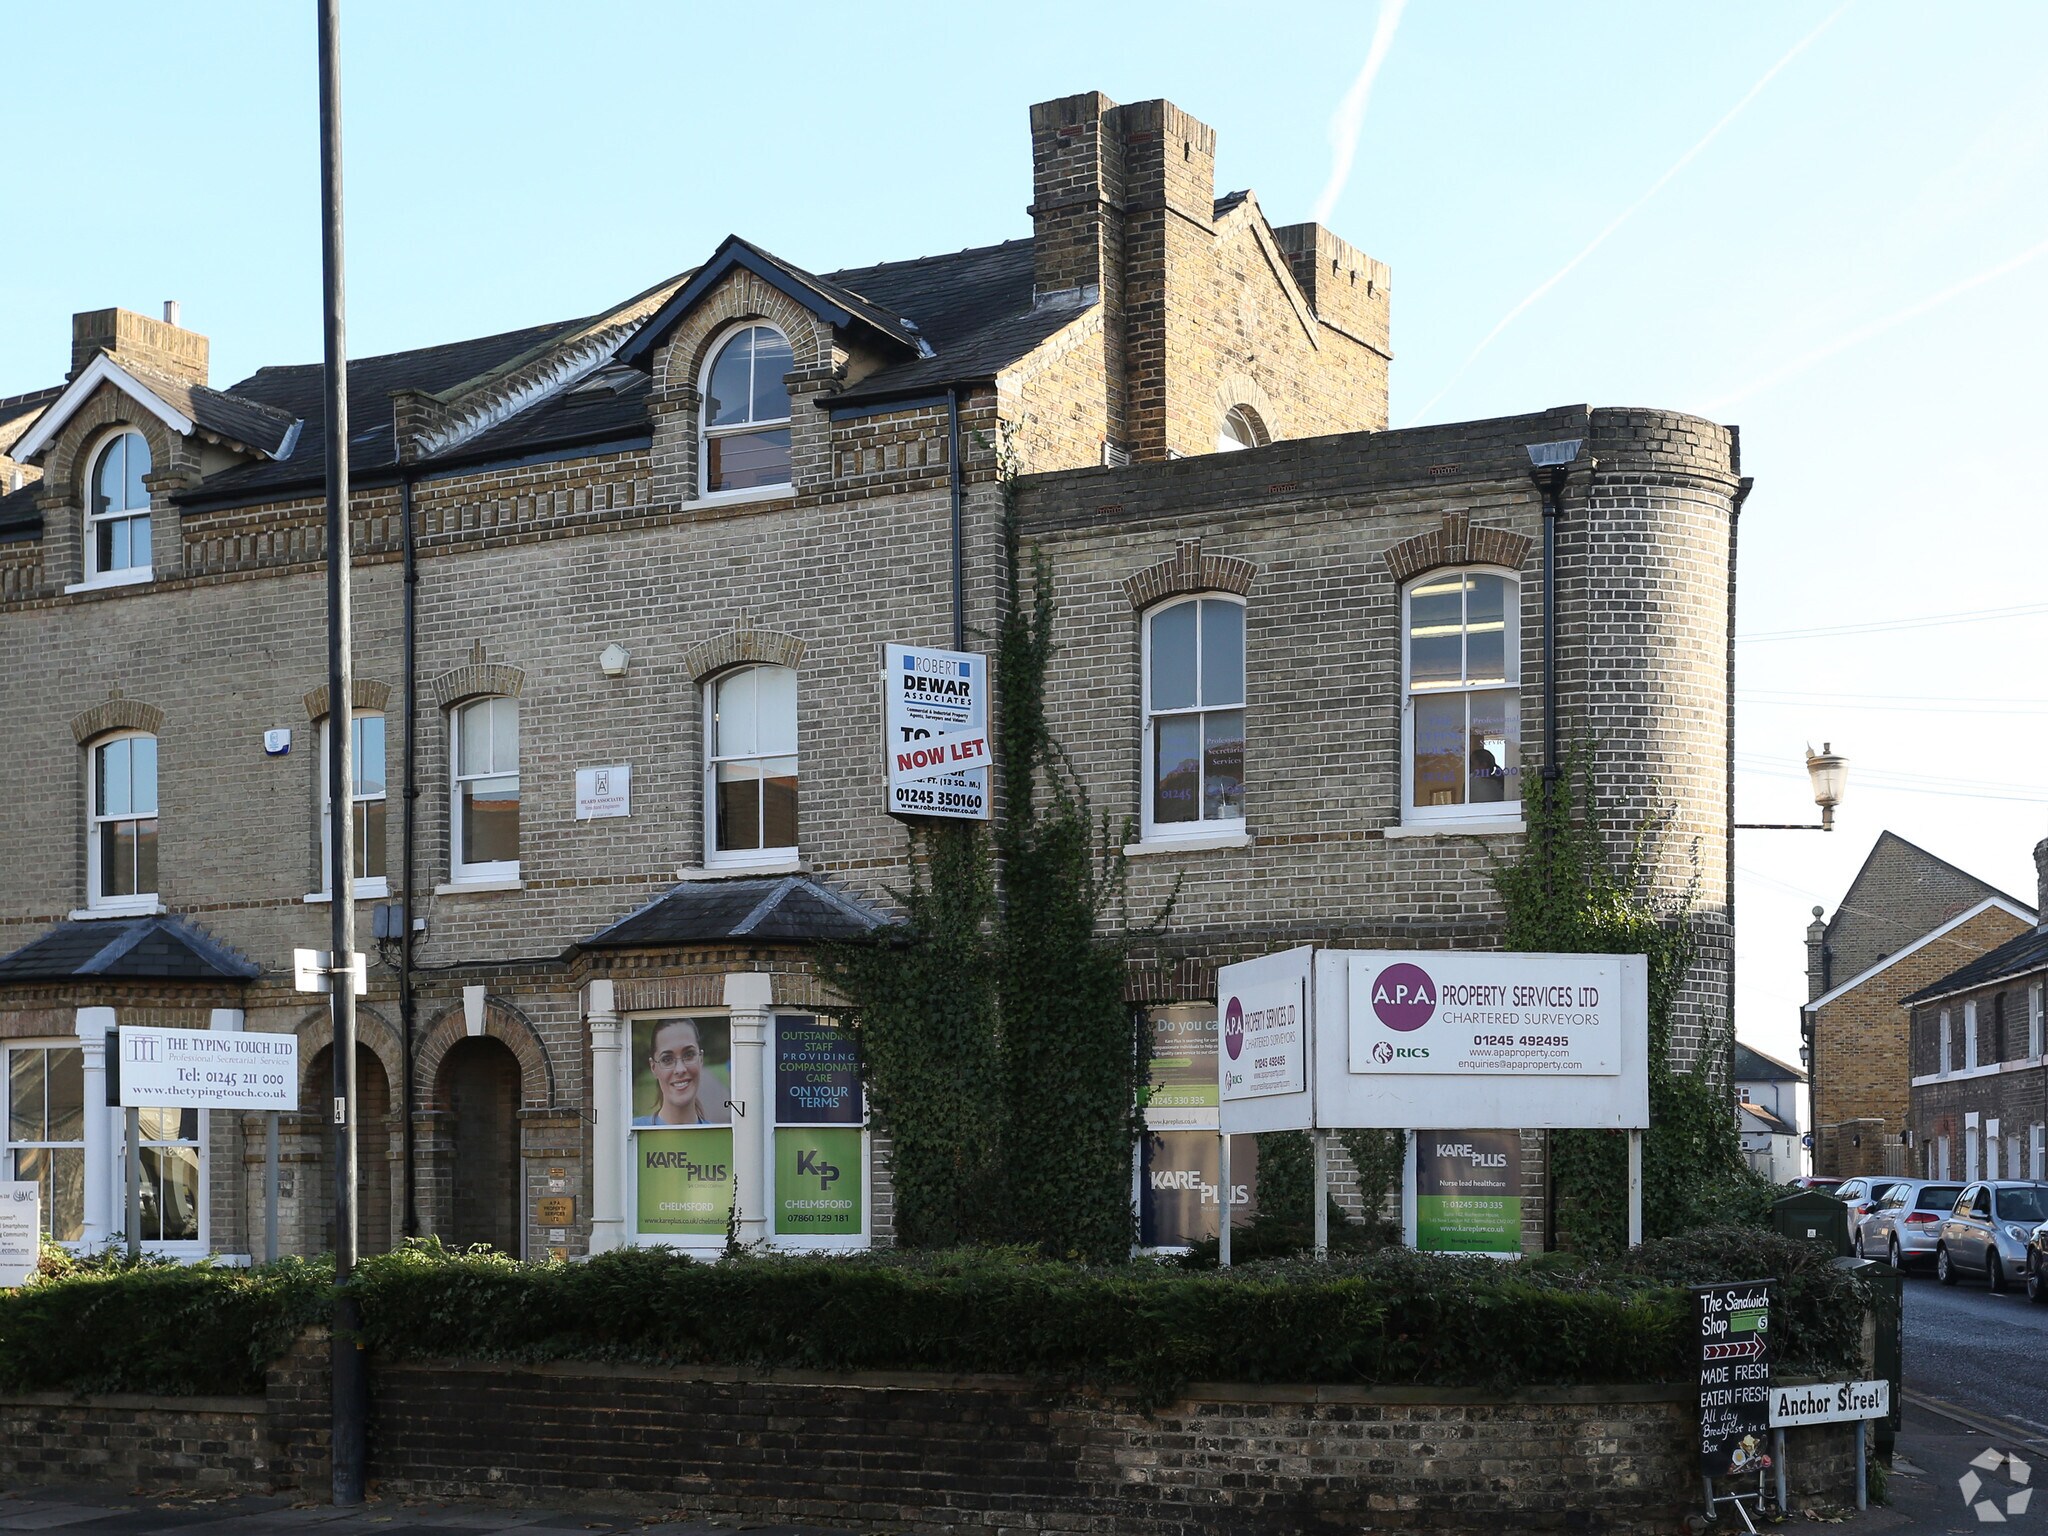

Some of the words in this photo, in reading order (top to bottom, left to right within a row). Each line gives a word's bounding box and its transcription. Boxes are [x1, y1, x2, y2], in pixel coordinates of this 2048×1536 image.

[916, 656, 958, 676] ROBERT
[904, 675, 970, 696] DEWAR
[904, 691, 972, 706] ASSOCIATES
[906, 706, 929, 714] Commercial
[897, 746, 944, 772] NOW
[950, 738, 984, 761] LET
[1212, 757, 1242, 766] Services
[1474, 768, 1488, 778] 211
[940, 778, 952, 786] (13
[968, 780, 980, 789] M.)
[896, 788, 934, 804] 01245
[938, 792, 982, 808] 350160
[1162, 789, 1192, 800] 01245
[901, 802, 979, 815] www.robertdewar.co.uk
[1372, 984, 1436, 1006] A.P.A.
[1442, 984, 1507, 1006] PROPERTY
[1512, 986, 1572, 1008] SERVICES
[1578, 986, 1599, 1008] LTD
[1225, 1016, 1244, 1036] A.P.A.
[1244, 1010, 1265, 1032] PROPERTY
[1266, 1006, 1286, 1029] SERVICES
[1288, 1004, 1296, 1025] LTD
[1442, 1012, 1520, 1024] CHARTERED
[1524, 1012, 1600, 1026] SURVEYORS
[1158, 1019, 1176, 1032] Do
[1178, 1020, 1202, 1035] you
[1206, 1020, 1218, 1030] ca
[166, 1037, 188, 1050] THE
[192, 1038, 230, 1053] TYPING
[235, 1040, 270, 1054] TOUCH
[274, 1043, 293, 1055] LTD
[804, 1042, 833, 1052] STAFF
[1474, 1034, 1514, 1046] 01245
[1519, 1035, 1569, 1047] 492495
[168, 1053, 214, 1063] Professional
[216, 1055, 256, 1064] Secretarial
[260, 1056, 290, 1066] Services
[783, 1052, 855, 1060] PROVIDING
[1396, 1048, 1430, 1058] RICS
[1469, 1048, 1570, 1058] www.apaproperty.com
[780, 1062, 858, 1072] COMPASIONATE
[1458, 1060, 1582, 1070] enquiries@apaproperty.com
[177, 1068, 200, 1082] Tel:
[205, 1072, 237, 1086] 01245
[242, 1074, 258, 1084] 211
[262, 1074, 284, 1085] 000
[806, 1074, 832, 1082] CARE
[132, 1086, 287, 1099] www.thetypingtouch.co.uk
[790, 1086, 811, 1097] ON
[812, 1086, 848, 1097] YOUR
[798, 1097, 840, 1108] TERMS
[1174, 1096, 1188, 1104] 330
[1190, 1096, 1204, 1104] 335
[1436, 1144, 1472, 1157] KARE
[1472, 1152, 1507, 1167] PLUS
[646, 1152, 687, 1168] KARE
[687, 1162, 728, 1182] PLUS
[1150, 1170, 1200, 1190] KARE
[659, 1202, 714, 1212] CHELMSFORD
[785, 1200, 852, 1209] CHELMSFORD
[1442, 1200, 1449, 1208] T:
[1474, 1201, 1488, 1209] 330
[788, 1214, 814, 1222] 07860
[1440, 1225, 1504, 1234] www.kareplus.co.uk
[1700, 1290, 1722, 1314] The
[1724, 1288, 1769, 1311] Sandwich
[1702, 1314, 1728, 1339] Shop
[1700, 1366, 1729, 1386] MADE
[1735, 1363, 1768, 1380] FRESH
[1700, 1389, 1732, 1408] EATEN
[1734, 1386, 1769, 1404] FRESH
[1778, 1391, 1830, 1417] Anchor
[1838, 1387, 1880, 1411] Street
[1700, 1409, 1716, 1424] All
[1720, 1407, 1738, 1426] day
[1702, 1422, 1744, 1440] Breakfast
[1748, 1423, 1757, 1432] in
[1702, 1440, 1718, 1454] Box
